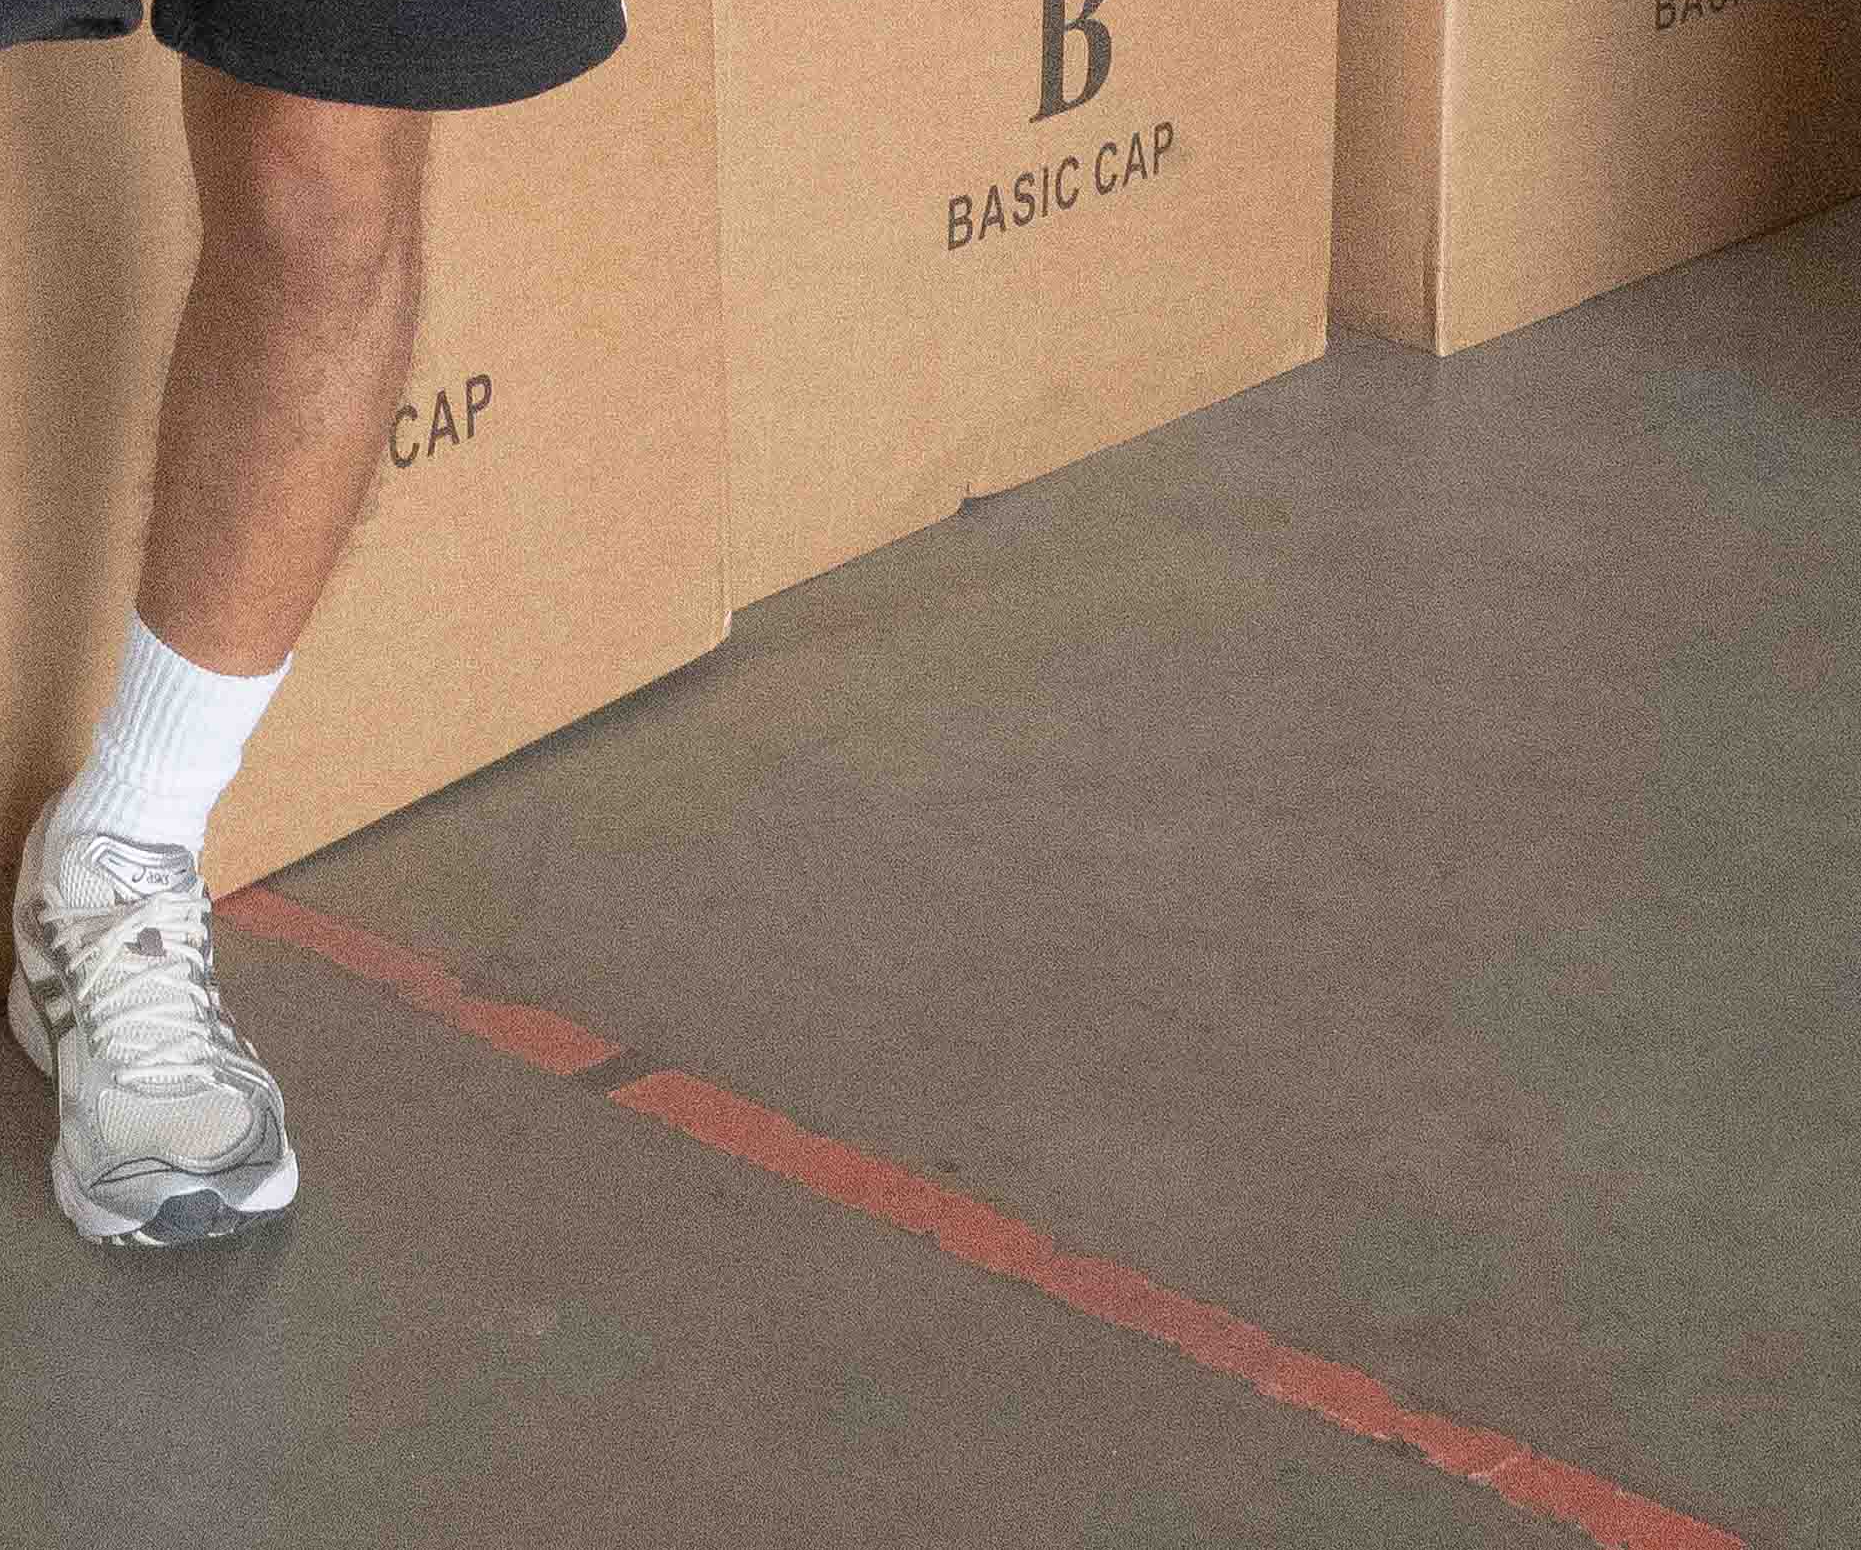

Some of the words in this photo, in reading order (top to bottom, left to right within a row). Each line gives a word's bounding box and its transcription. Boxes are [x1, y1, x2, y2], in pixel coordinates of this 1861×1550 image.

[947, 155, 1080, 250] BASIC
[1094, 121, 1174, 196] CAP
[390, 374, 492, 469] CAP
